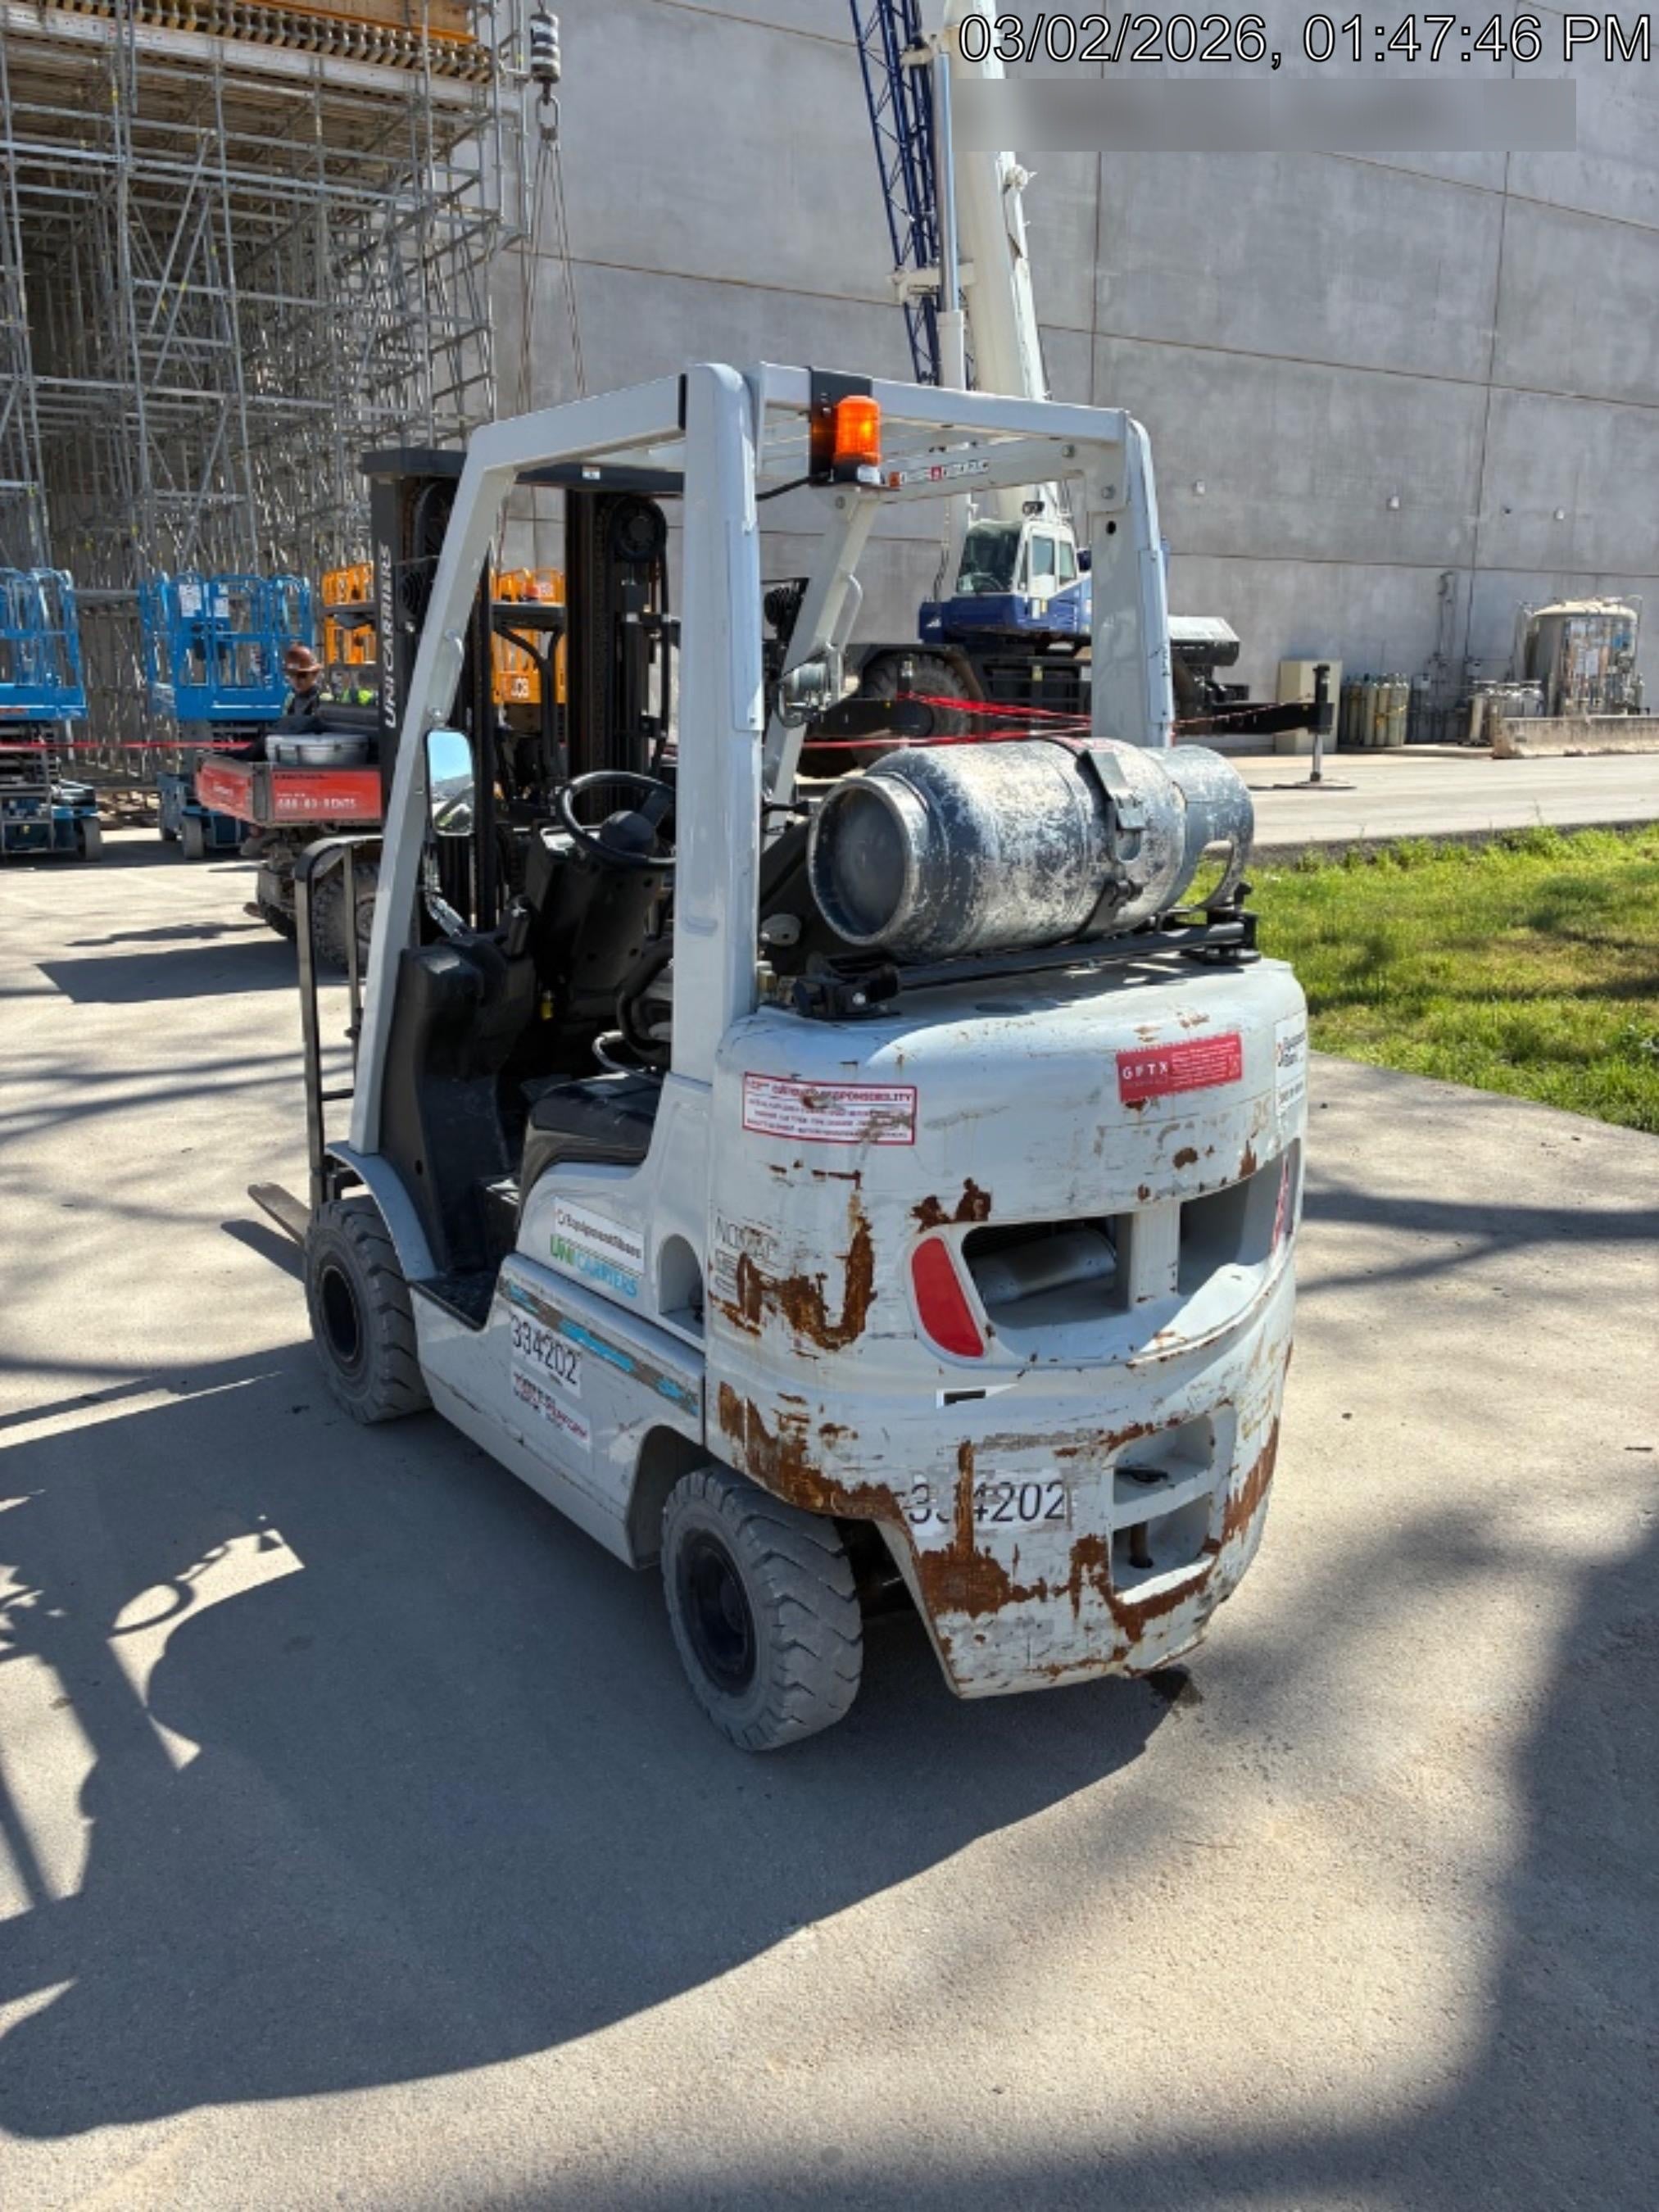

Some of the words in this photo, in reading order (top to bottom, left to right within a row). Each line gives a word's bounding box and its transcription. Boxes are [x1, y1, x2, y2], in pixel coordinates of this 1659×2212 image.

[379, 542, 397, 728] UNICARRIERS
[821, 1090, 913, 1103] ESPONSIBILITY
[550, 1233, 637, 1299] UNICARRIERS
[510, 1313, 578, 1385] 334202
[908, 1479, 1066, 1525] 34202
